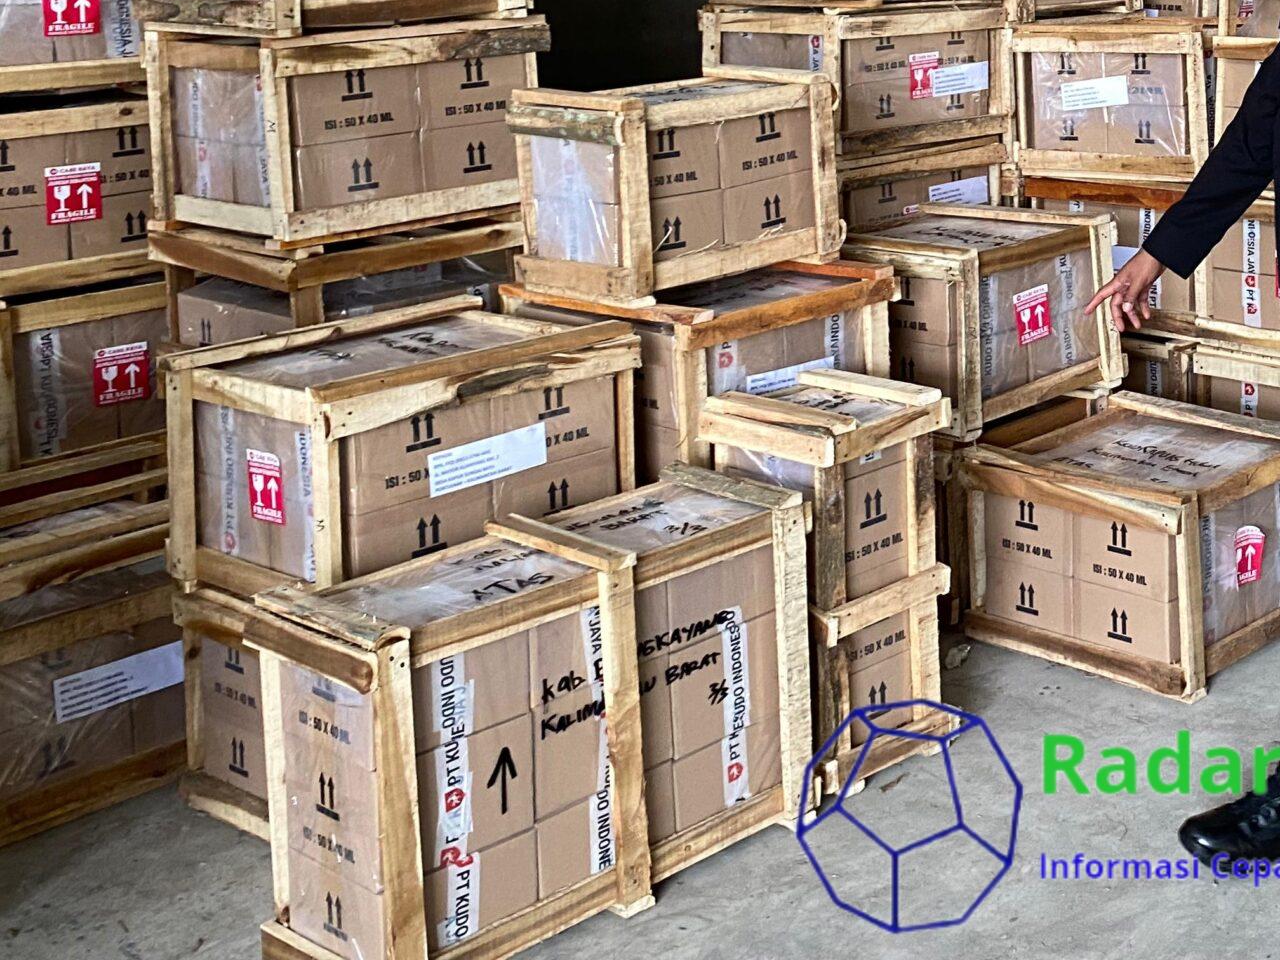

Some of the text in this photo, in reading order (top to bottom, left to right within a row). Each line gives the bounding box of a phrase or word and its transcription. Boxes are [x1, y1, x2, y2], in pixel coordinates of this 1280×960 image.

[48, 22, 95, 32] FRAGILE
[445, 106, 457, 116] ISI
[463, 104, 474, 113] 50
[475, 102, 482, 112] X
[483, 102, 495, 111] 40
[324, 112, 394, 130] ISI 50 X 40 ML
[742, 150, 798, 172] ISI 50 X 40 ML
[654, 170, 698, 186] 50 X 40 ML
[51, 208, 97, 220] FRAGILE
[1021, 326, 1049, 340] FRAGILE
[553, 432, 560, 445] X
[562, 430, 574, 442] 40
[576, 427, 589, 440] ML
[385, 476, 399, 489] ISI
[408, 471, 422, 483] 50
[253, 506, 282, 519] FRAGILE
[861, 545, 872, 557] 50
[873, 541, 879, 552] X
[880, 538, 890, 550] 40
[892, 534, 904, 545] ML
[1016, 542, 1025, 552] 50
[1026, 544, 1031, 553] X
[1032, 545, 1041, 556] 40
[1042, 548, 1053, 559] ML
[1093, 563, 1147, 585] ISI 50 X 40 ML
[864, 643, 875, 657] 50
[876, 641, 882, 652] X
[883, 636, 894, 648] 40
[895, 630, 907, 643] ML
[440, 692, 456, 729] INDO
[313, 717, 322, 731] 50
[323, 721, 329, 735] X
[729, 742, 741, 761] PT
[446, 766, 461, 787] PT
[454, 869, 471, 938] PT KUDO
